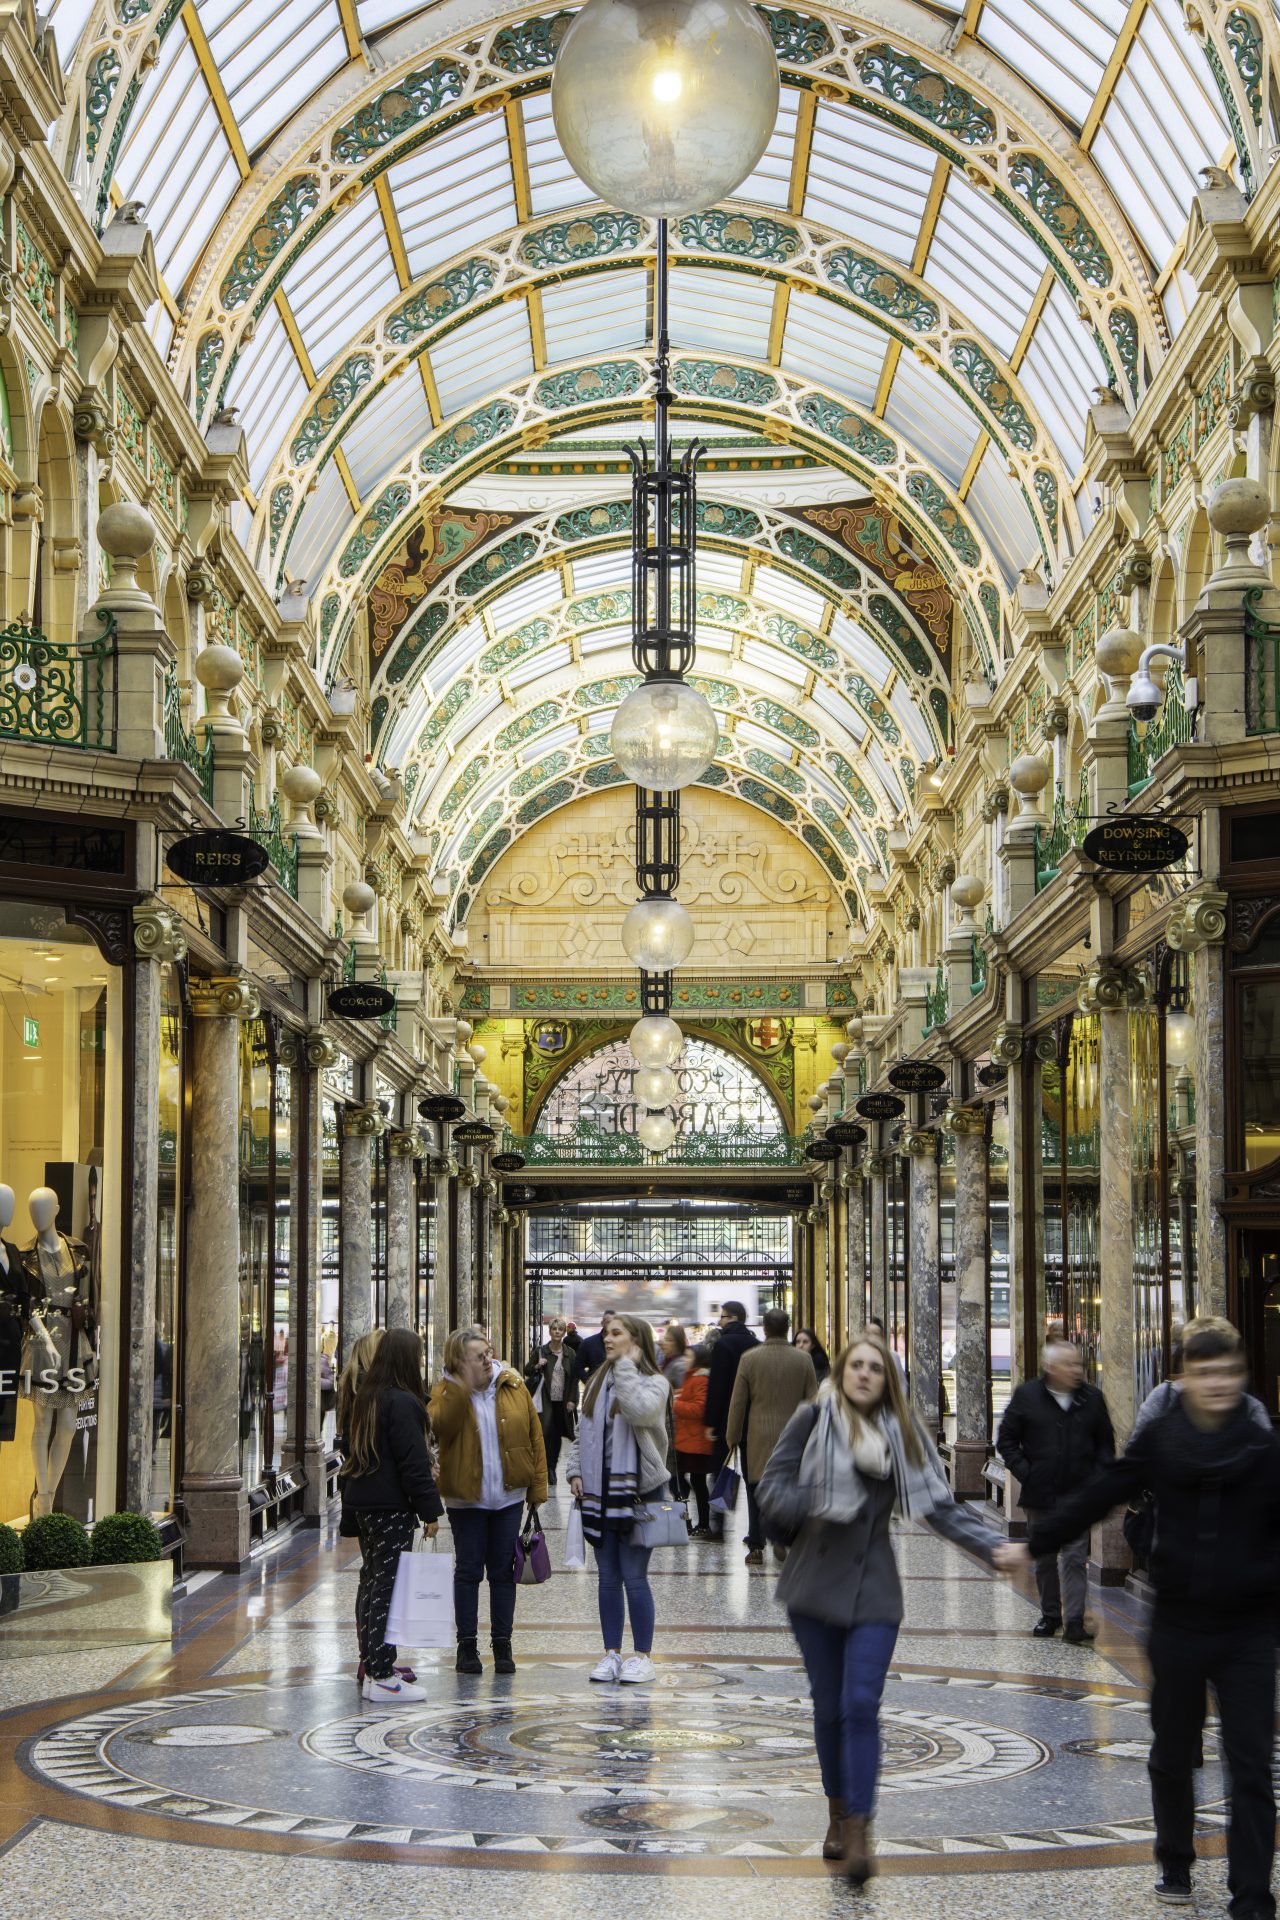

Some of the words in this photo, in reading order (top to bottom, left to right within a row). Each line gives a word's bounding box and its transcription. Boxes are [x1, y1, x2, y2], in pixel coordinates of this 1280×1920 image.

[381, 580, 405, 594] PEACE
[1103, 828, 1170, 839] DOWSING
[1133, 839, 1141, 849] &
[195, 853, 241, 866] REISS
[1098, 850, 1175, 861] REYNOLDS
[340, 997, 383, 1006] COACH
